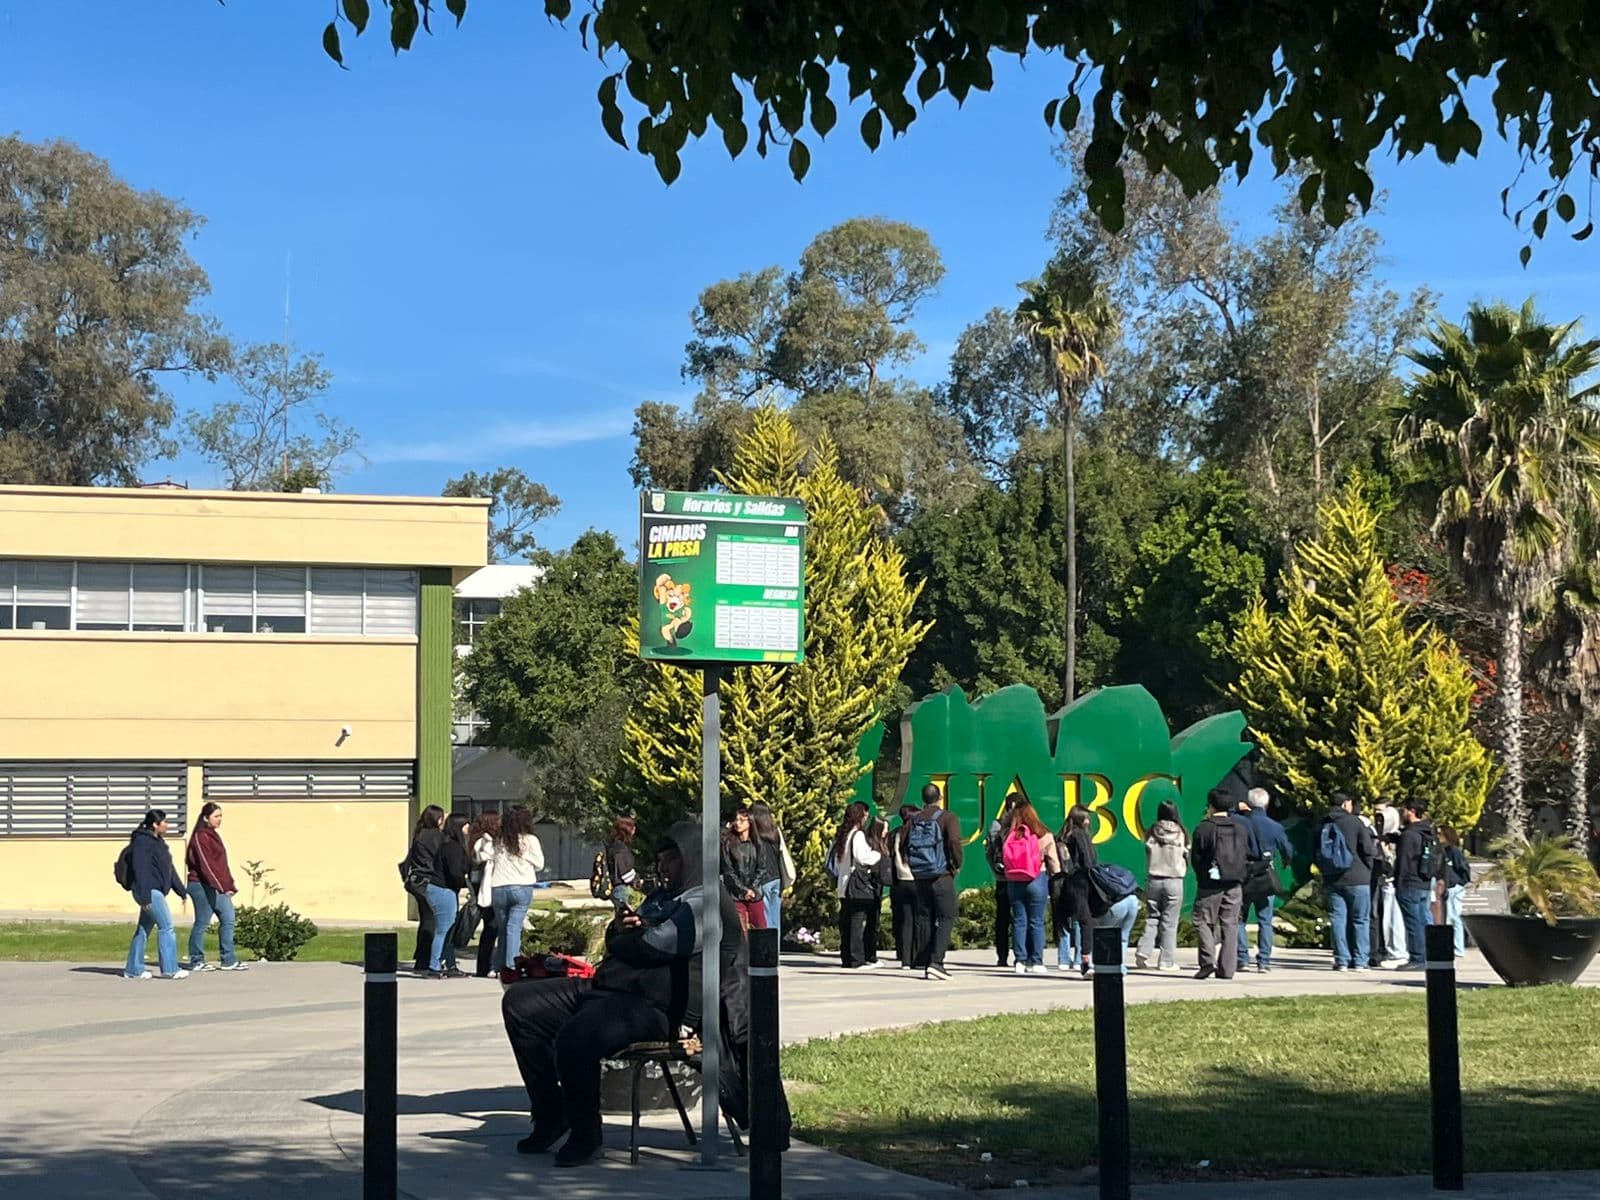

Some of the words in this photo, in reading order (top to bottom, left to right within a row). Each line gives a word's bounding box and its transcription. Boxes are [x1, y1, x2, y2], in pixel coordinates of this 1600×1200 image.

[682, 498, 732, 514] Horarios
[733, 502, 743, 516] y
[743, 501, 786, 517] Salidas
[649, 523, 707, 543] CIMABUS
[648, 543, 663, 558] LA
[664, 541, 700, 557] PRESA
